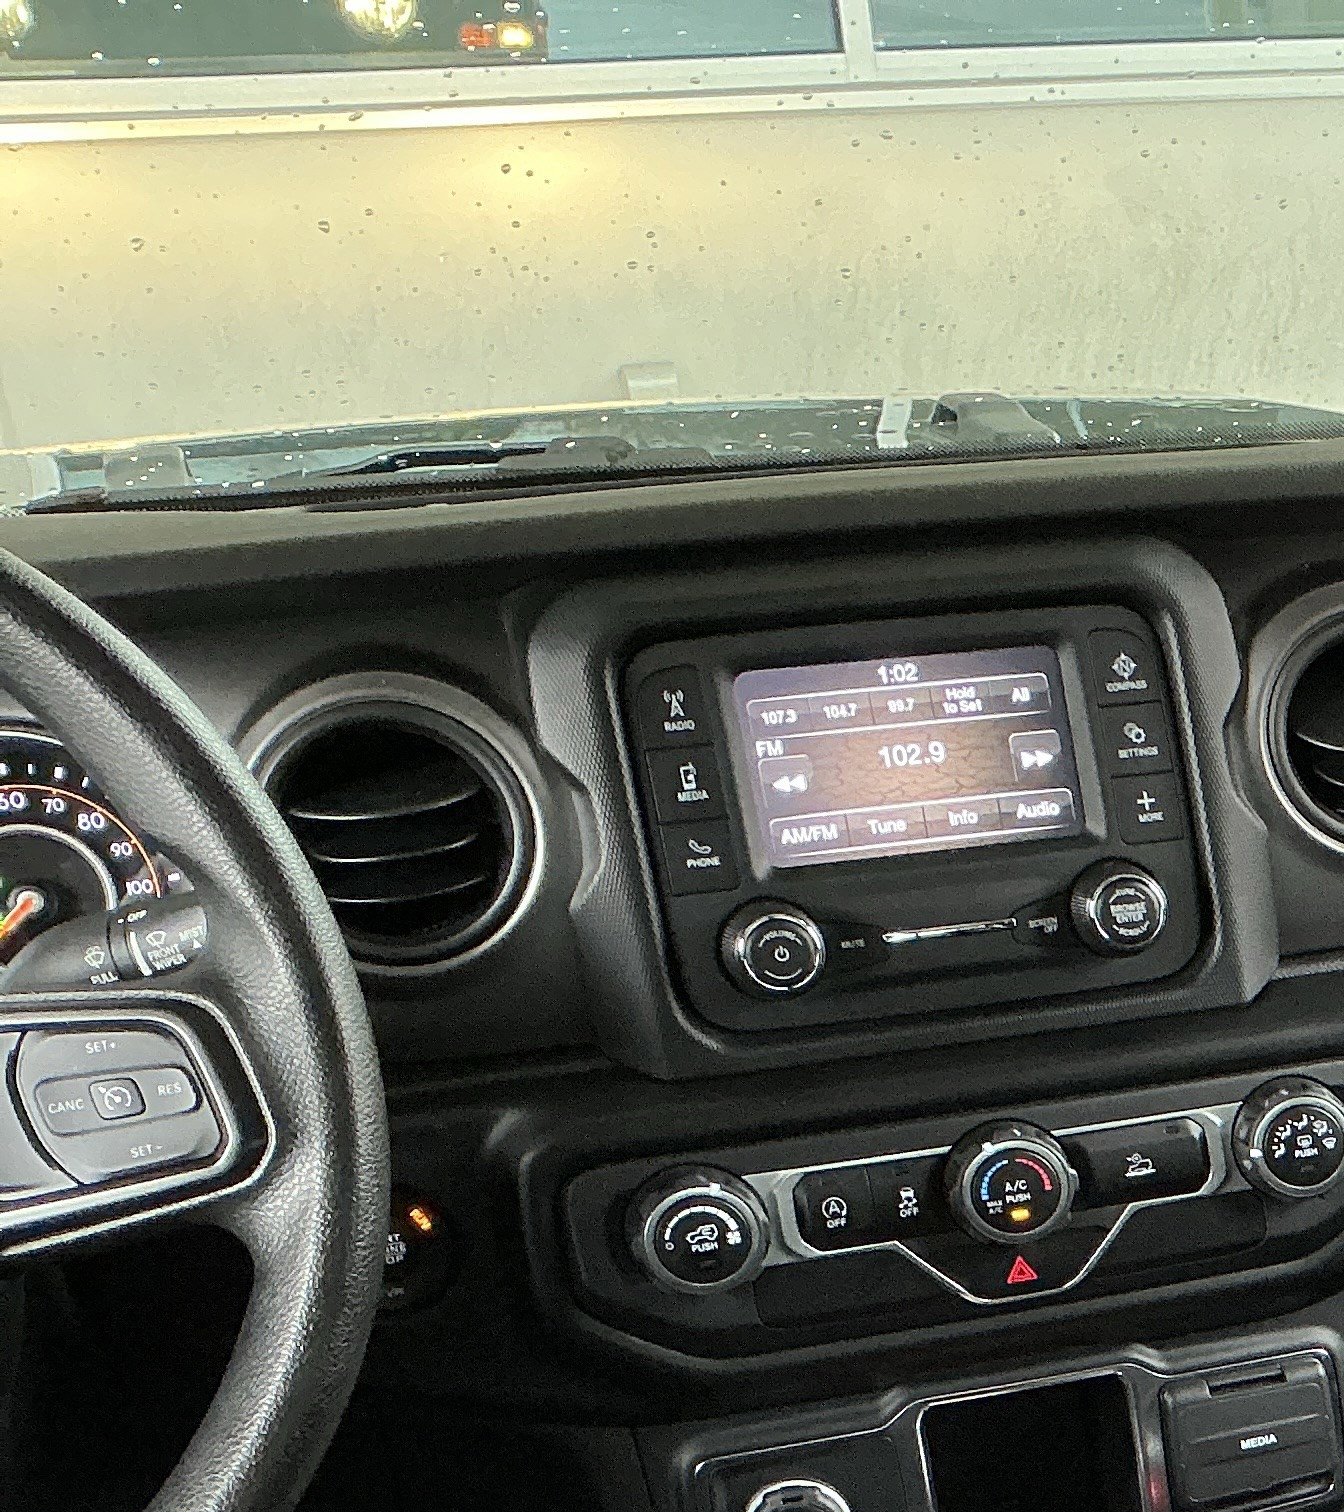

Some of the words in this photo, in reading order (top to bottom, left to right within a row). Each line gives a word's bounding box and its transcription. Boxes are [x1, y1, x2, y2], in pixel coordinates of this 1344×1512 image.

[877, 662, 919, 685] 1:02
[945, 686, 976, 700] Hold
[823, 702, 858, 719] 104.7
[943, 702, 957, 714] to
[959, 699, 982, 712] Set
[664, 720, 696, 732] RADIO
[755, 740, 784, 758] FM
[878, 740, 946, 768] 102.9
[677, 790, 710, 802] MEDIA
[41, 798, 65, 814] 70
[1016, 803, 1060, 820] Audio
[77, 812, 105, 831] 80
[948, 810, 978, 827] Info
[1138, 811, 1165, 823] MORE
[780, 823, 839, 846] AM/FM
[867, 818, 907, 836] Tune
[109, 841, 133, 857] 90
[686, 856, 721, 869] PHONE
[126, 879, 153, 896] 100
[147, 943, 179, 960] FRONT
[151, 953, 187, 970] WIPER
[90, 971, 119, 985] PULL
[157, 1083, 182, 1097] RES
[48, 1099, 84, 1114] CANC
[1005, 1180, 1028, 1192] A/C
[1005, 1192, 1032, 1204] PUSH
[899, 1206, 919, 1218] OFF
[826, 1218, 847, 1229] OFF
[691, 1241, 719, 1253] PUSH
[1240, 1433, 1278, 1450] MEDIA
